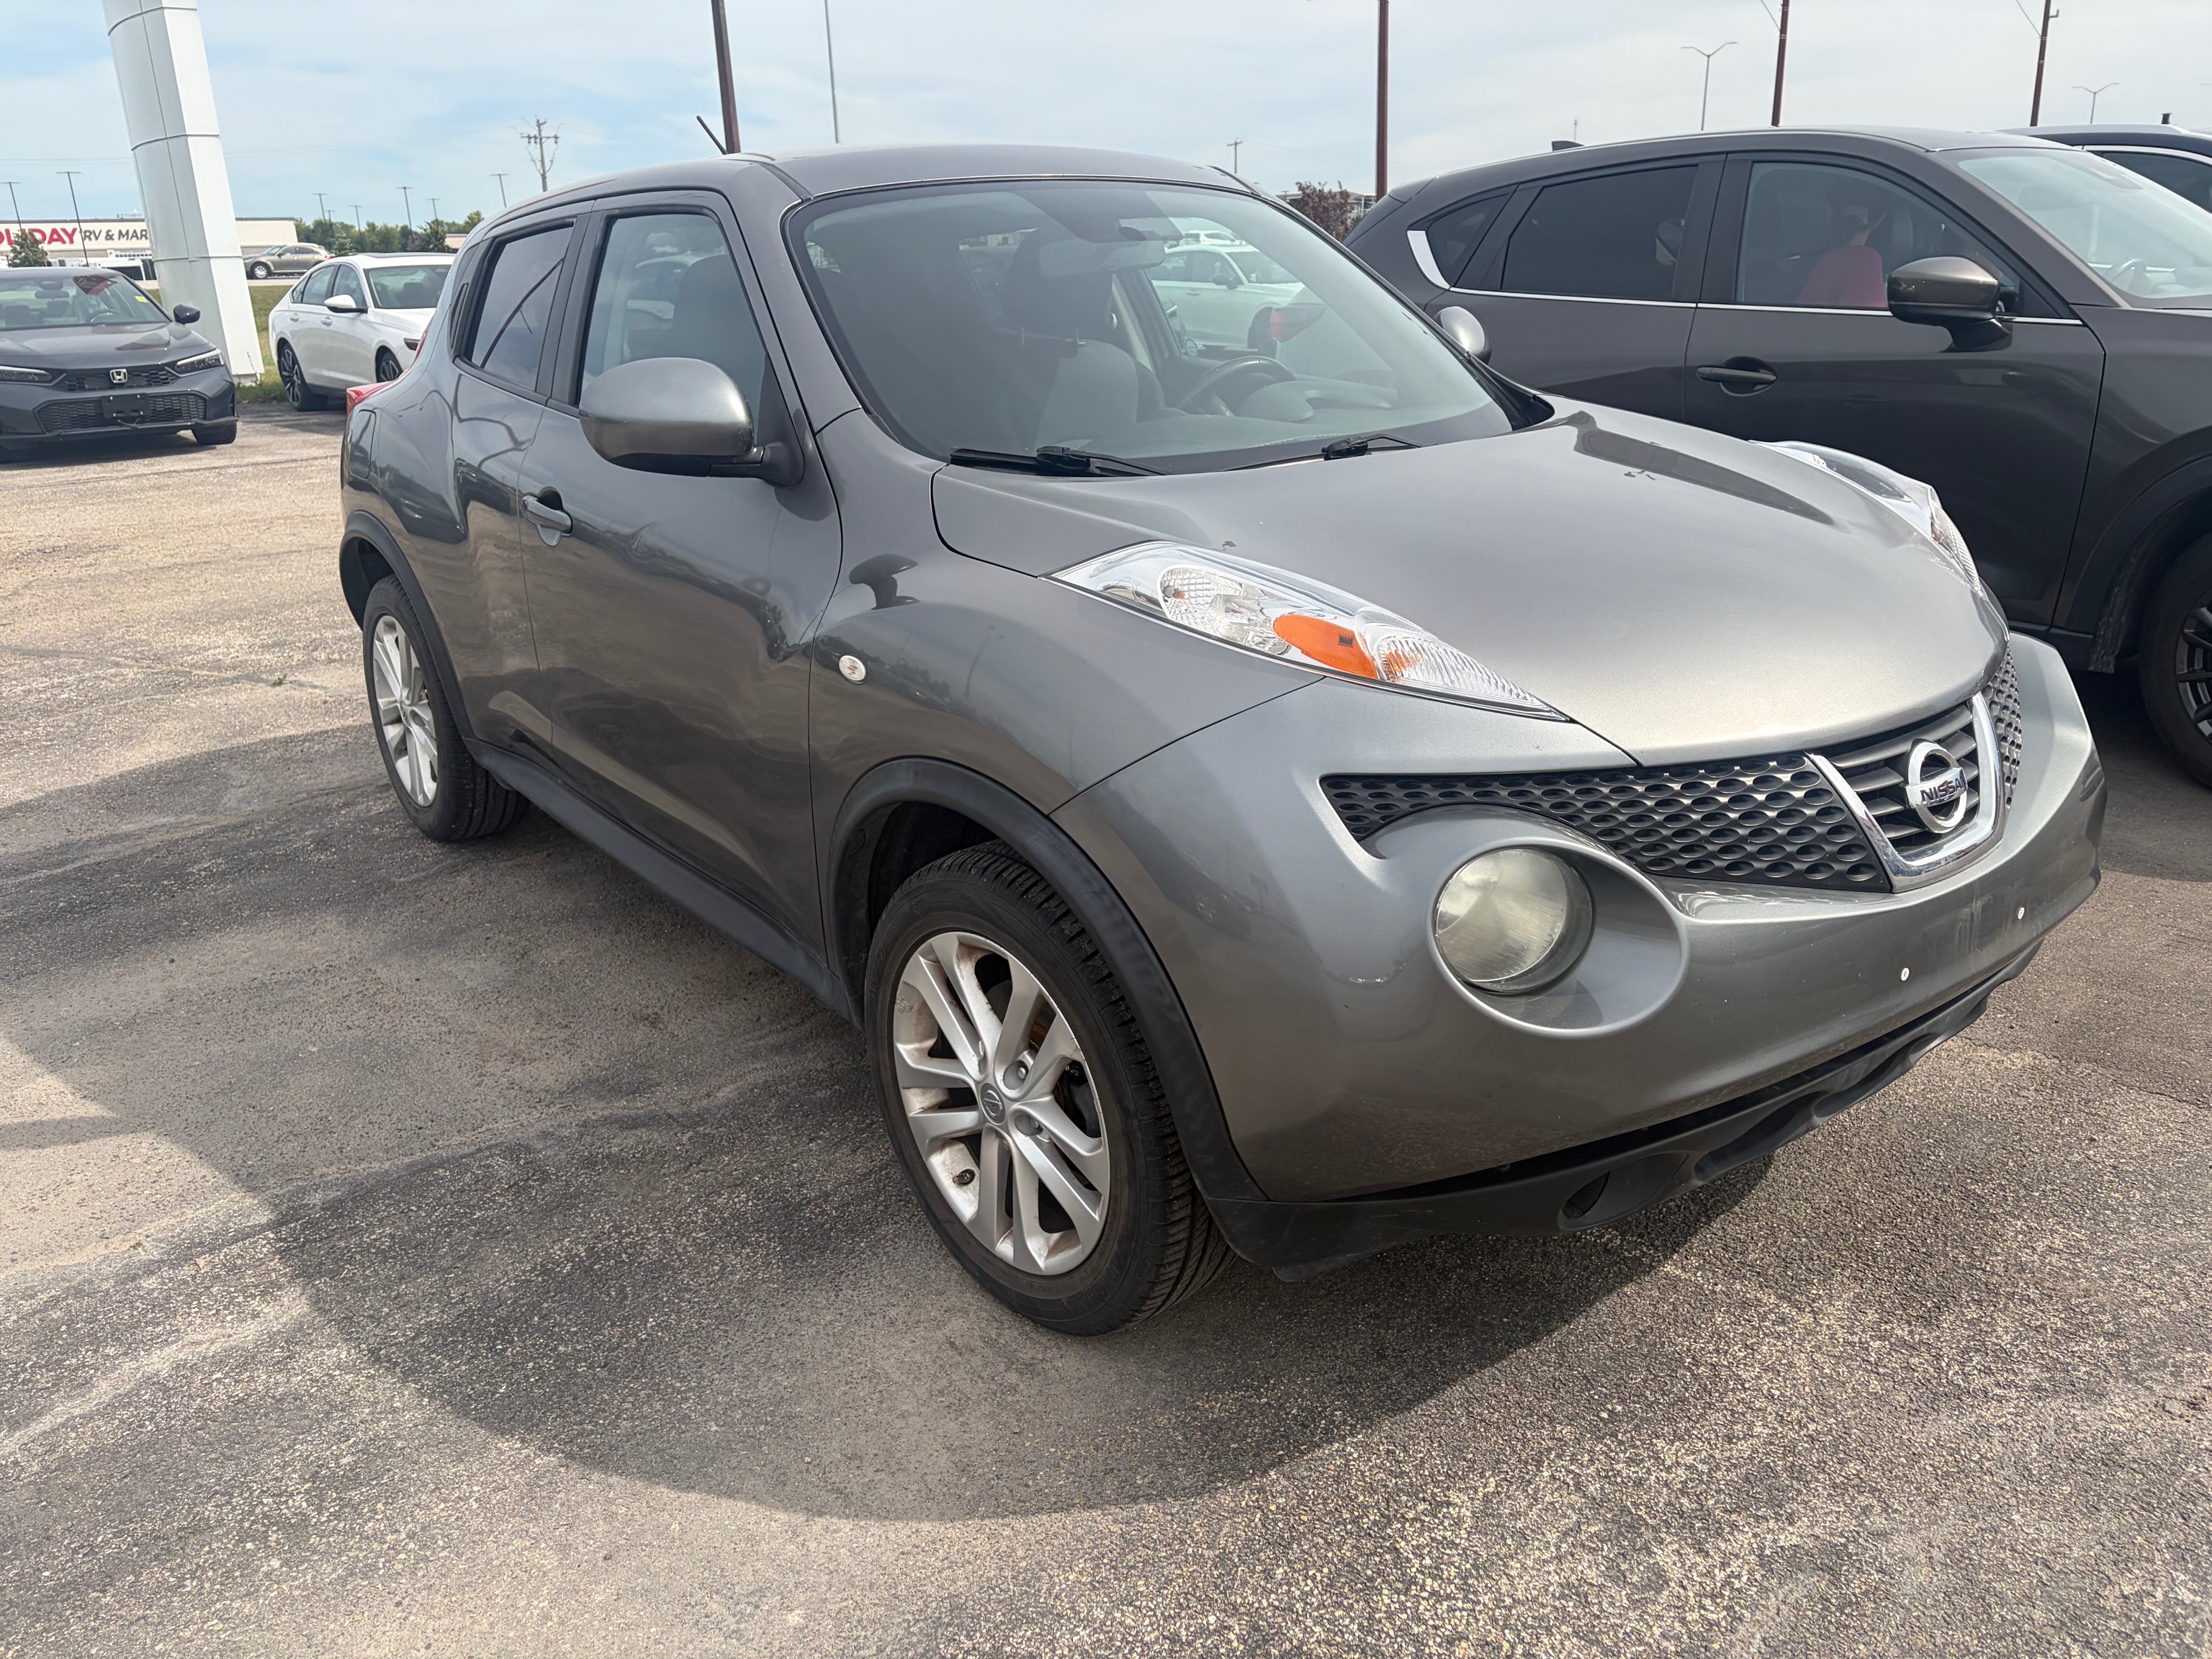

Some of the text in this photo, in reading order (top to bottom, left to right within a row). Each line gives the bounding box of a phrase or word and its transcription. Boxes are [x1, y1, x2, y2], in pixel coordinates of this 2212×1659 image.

[84, 230, 102, 241] RV
[104, 229, 114, 241] &
[1920, 777, 1967, 801] NISSAN
